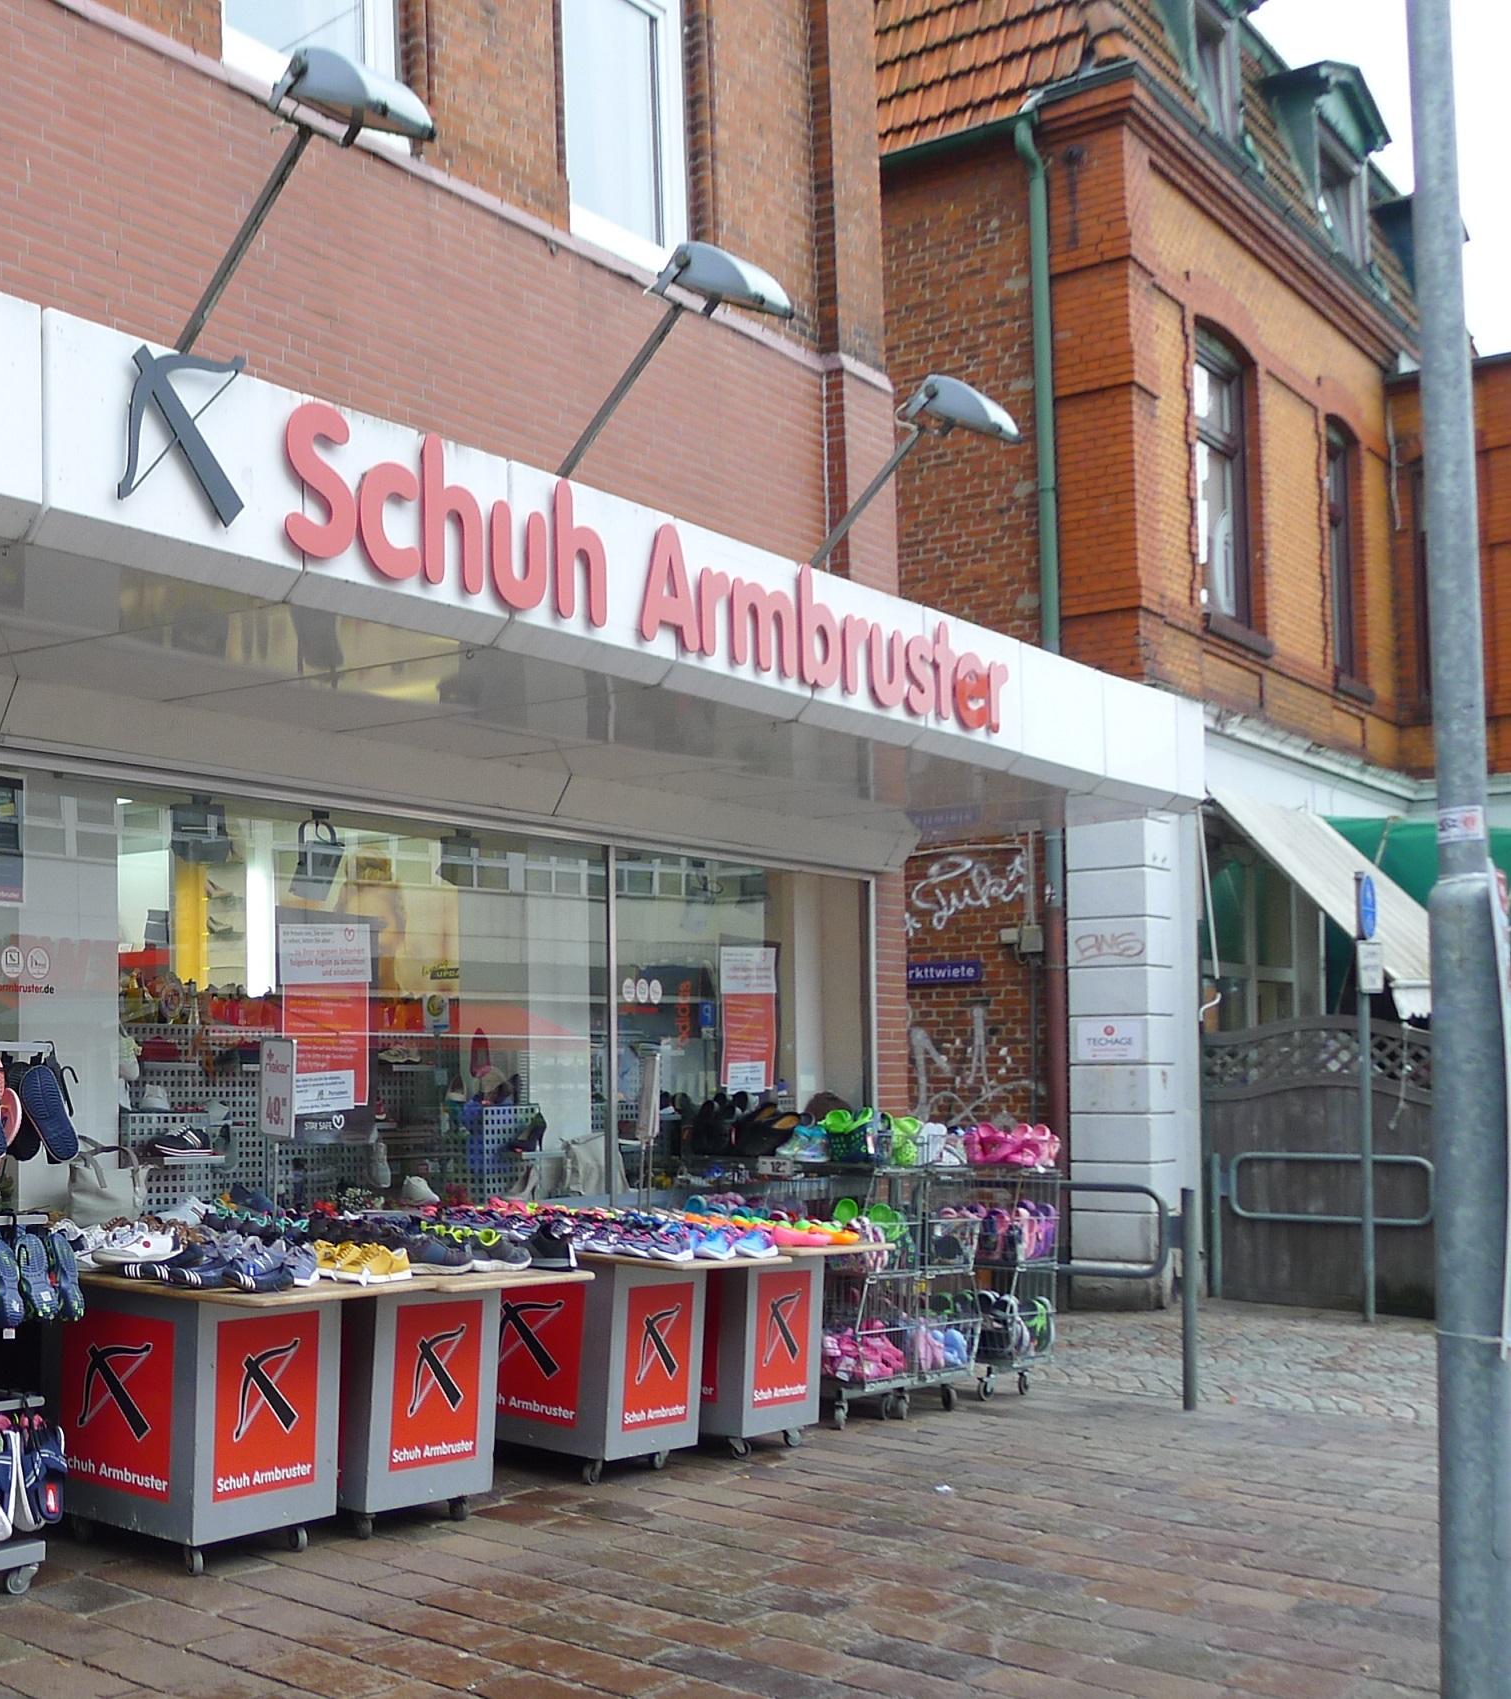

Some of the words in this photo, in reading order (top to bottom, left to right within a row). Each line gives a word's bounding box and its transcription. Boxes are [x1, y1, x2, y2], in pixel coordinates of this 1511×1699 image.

[285, 402, 607, 628] Schuh
[641, 522, 1009, 734] Armbruster
[908, 965, 976, 980] rkttwiete
[304, 1121, 318, 1130] STAY
[319, 1121, 333, 1130] SAFE
[753, 1388, 773, 1401] Schuh
[774, 1381, 808, 1398] Armbruster
[509, 1395, 576, 1421] Armbruster
[624, 1408, 646, 1424] Schuh
[647, 1403, 687, 1421] Armbruster
[392, 1446, 421, 1463] Schuh
[423, 1438, 474, 1457] Armbruster
[67, 1455, 95, 1474] chuh
[99, 1460, 169, 1492] Armbruster
[216, 1474, 251, 1493] Schuh
[253, 1461, 312, 1484] Armbruster
